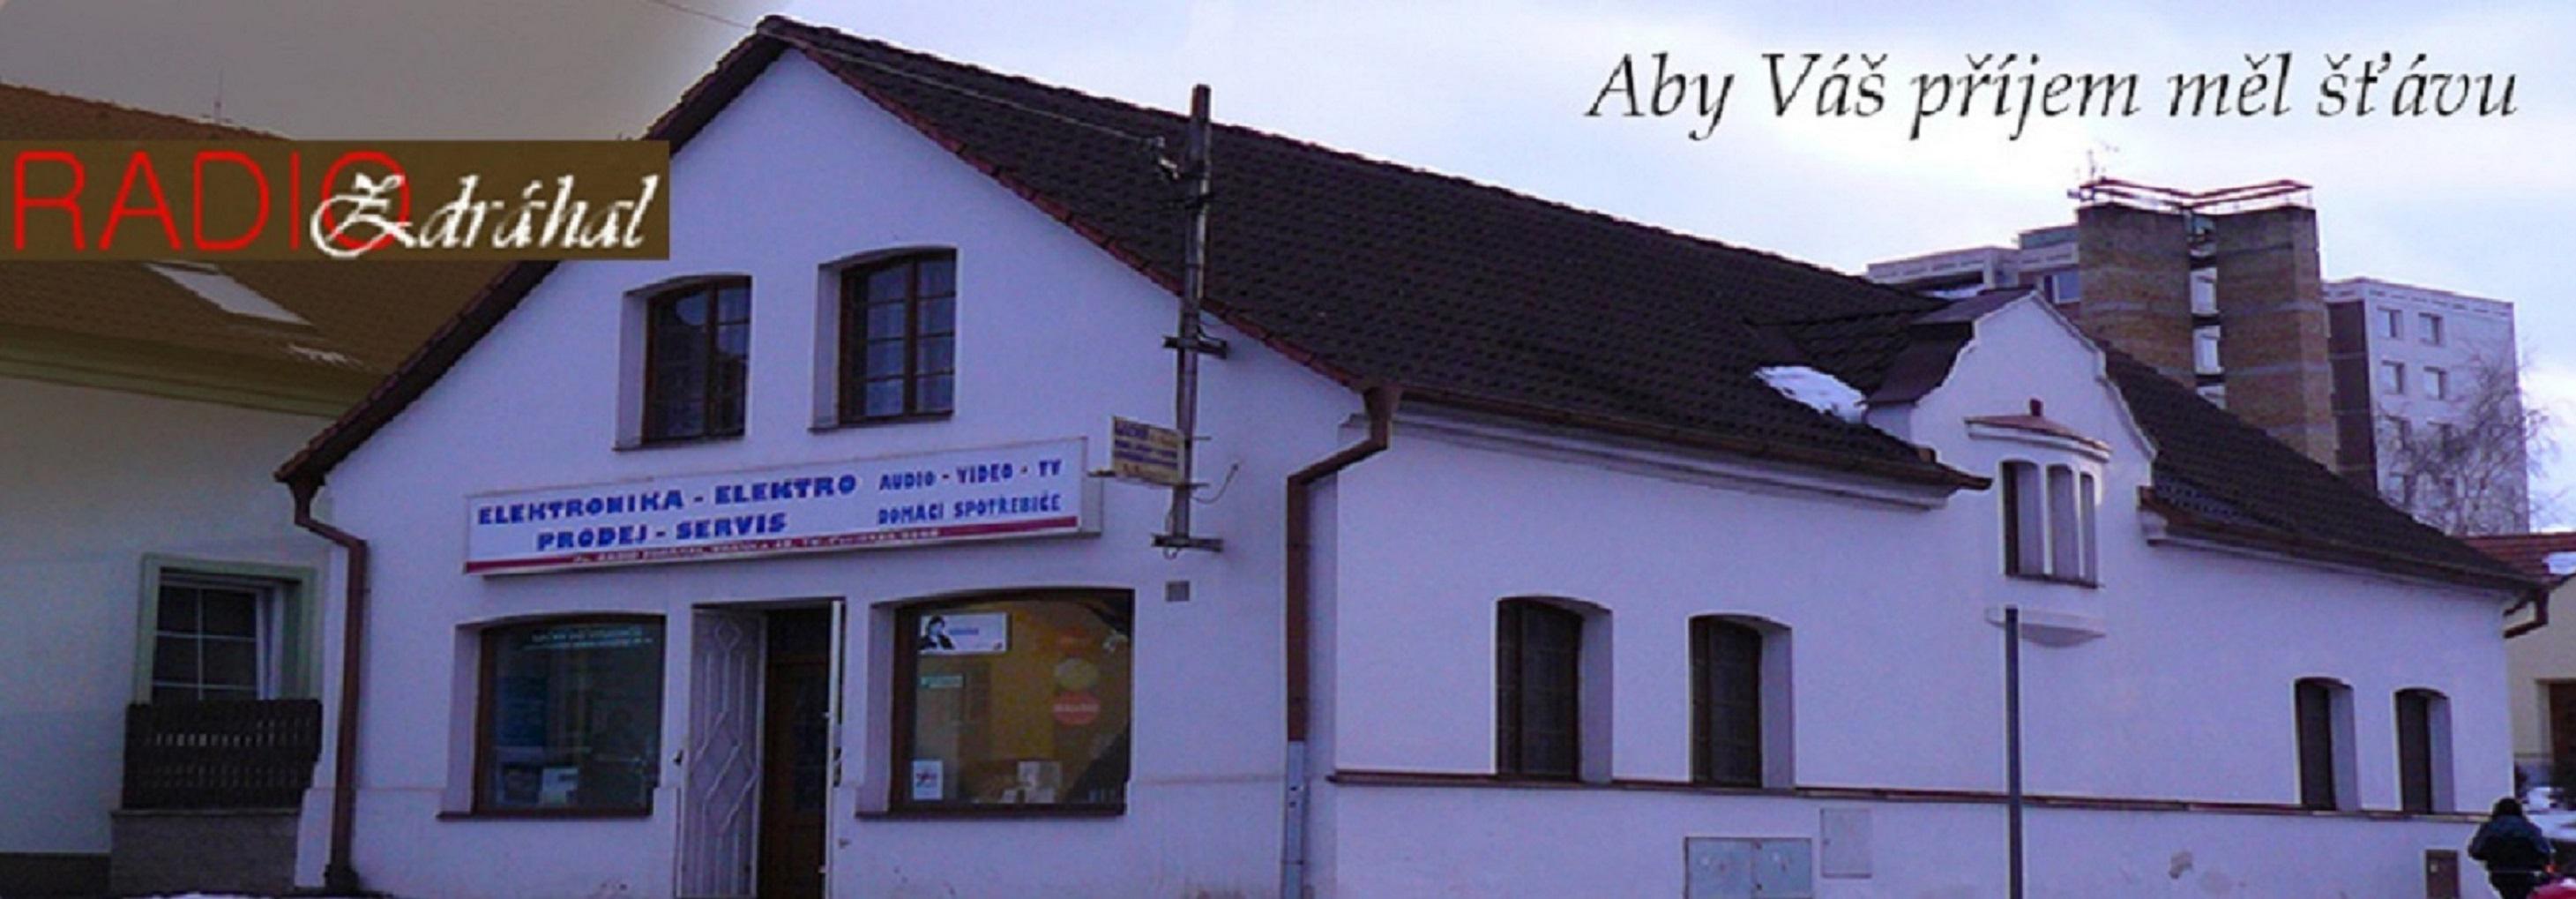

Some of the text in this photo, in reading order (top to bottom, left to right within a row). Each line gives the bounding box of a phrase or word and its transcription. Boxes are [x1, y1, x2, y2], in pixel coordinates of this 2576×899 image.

[879, 459, 1062, 491] AUDIO VIDEO TV
[478, 475, 858, 525] ELEKTRONIKA ELEKTRO
[538, 526, 648, 551] PRODEJ
[676, 513, 788, 540] SERVIS
